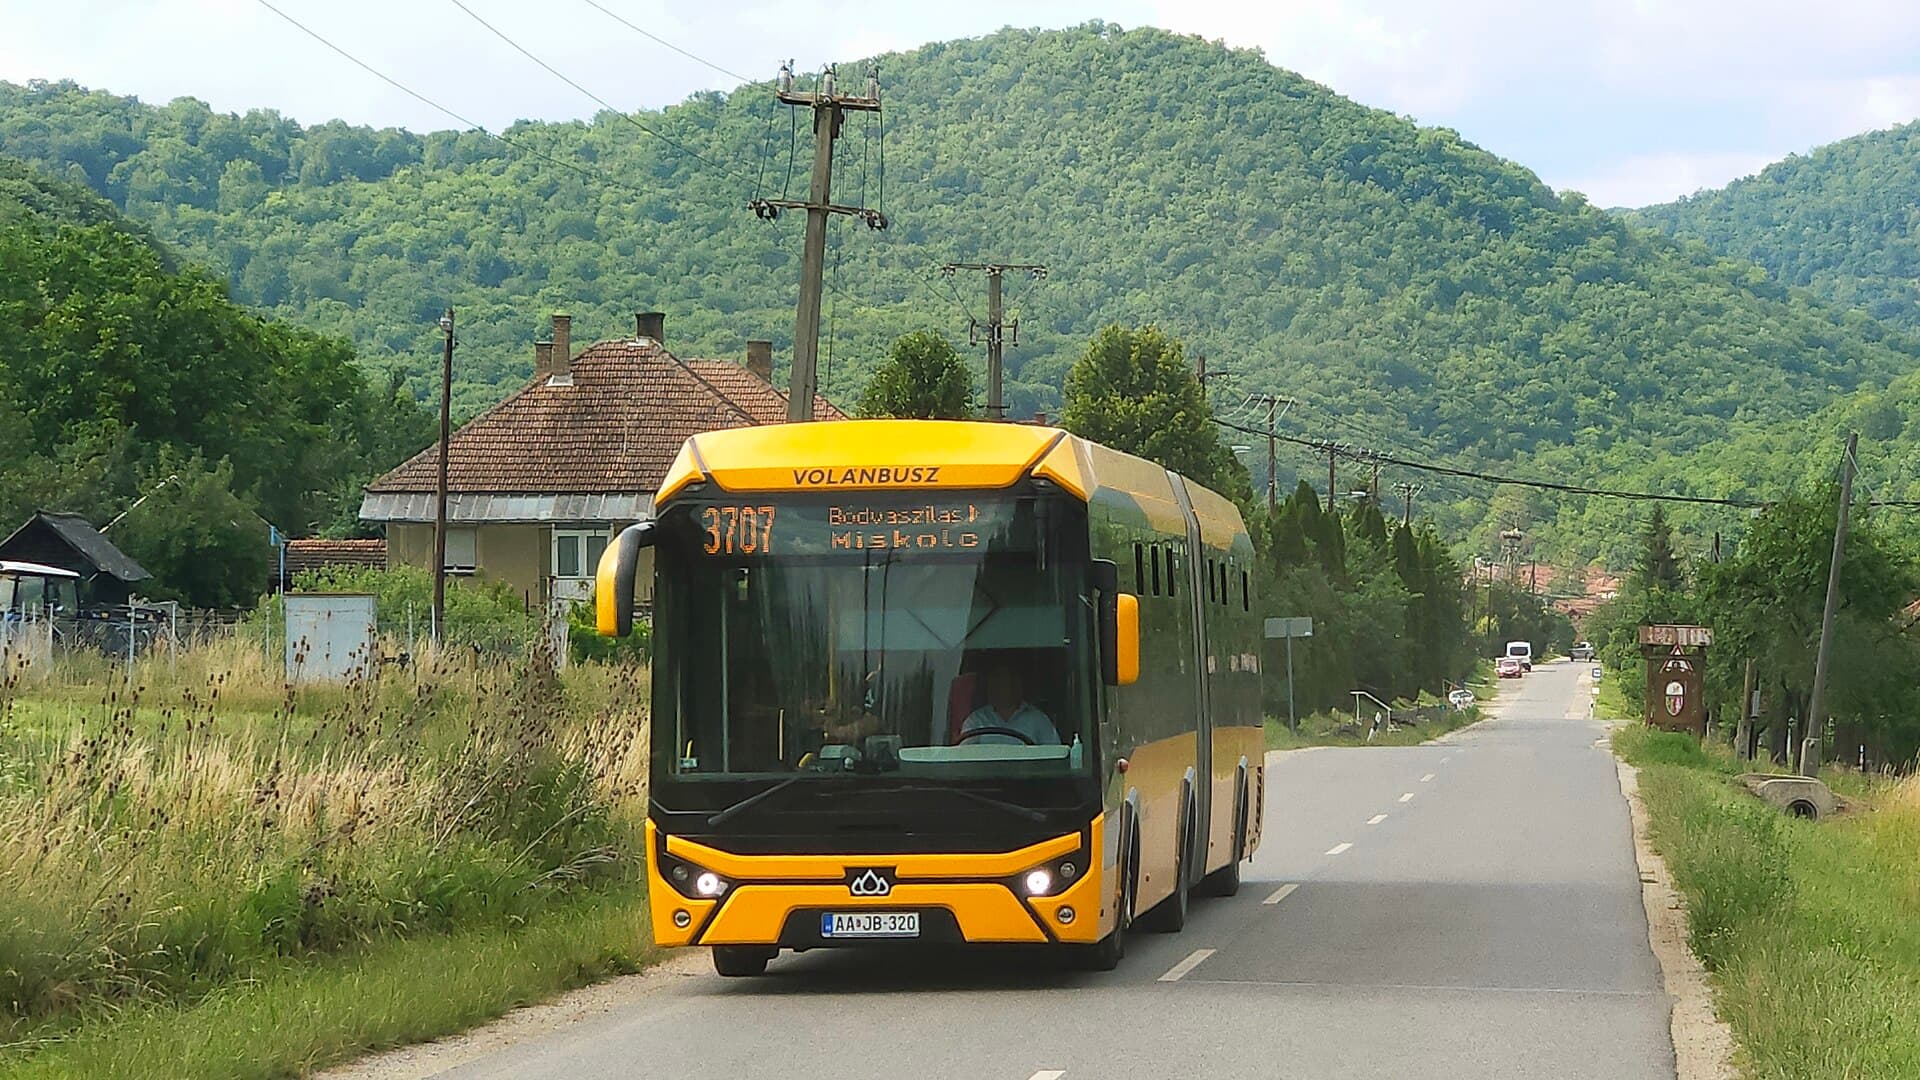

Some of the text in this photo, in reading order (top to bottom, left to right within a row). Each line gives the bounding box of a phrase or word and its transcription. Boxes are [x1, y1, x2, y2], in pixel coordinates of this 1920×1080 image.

[793, 467, 940, 485] VOLÁNBUSZ
[702, 506, 776, 554] 3707
[831, 529, 979, 549] Miskolc
